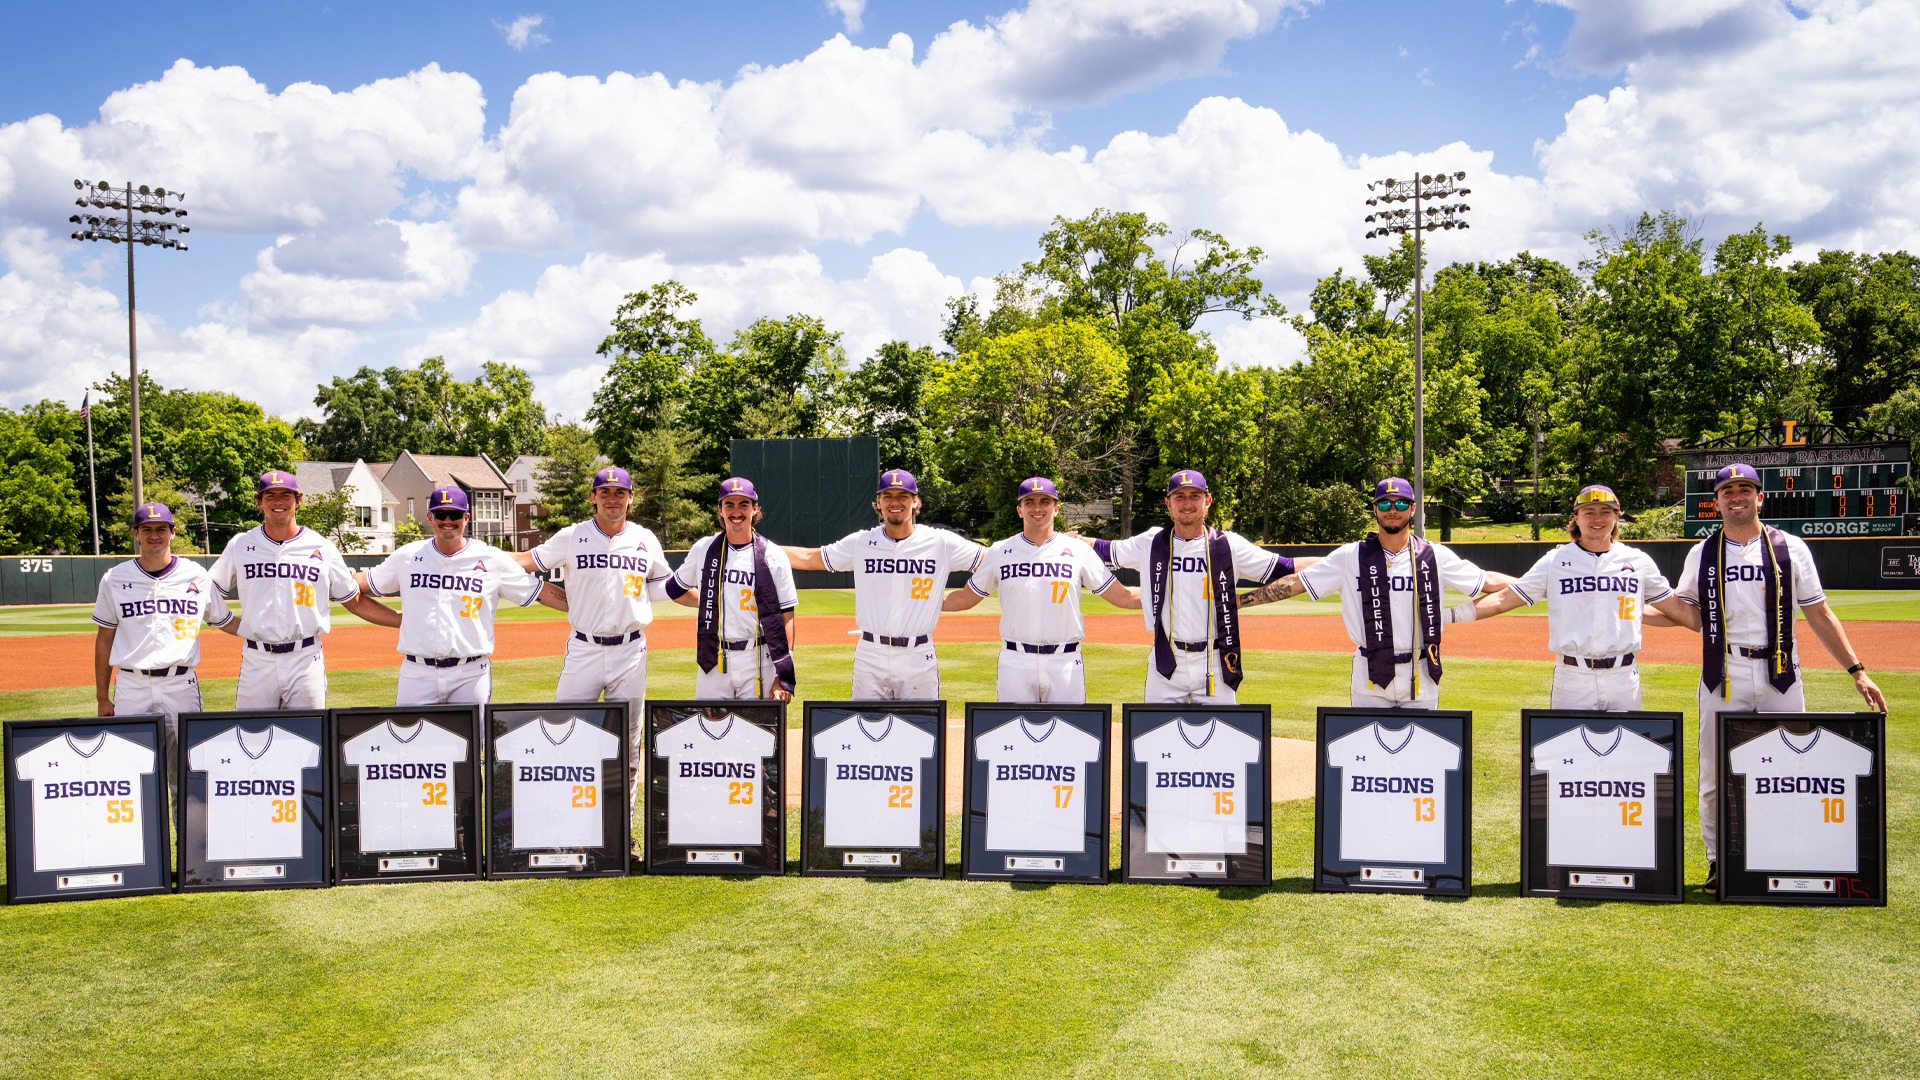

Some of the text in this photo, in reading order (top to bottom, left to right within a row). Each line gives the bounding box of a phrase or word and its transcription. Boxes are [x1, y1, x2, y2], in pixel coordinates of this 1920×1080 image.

[1782, 419, 1807, 447] L
[1706, 448, 1884, 467] LIPSCOMB BASEBALL
[271, 473, 284, 485] L
[607, 470, 618, 482] L
[1180, 473, 1192, 485] L
[1698, 472, 1704, 480] AT
[1729, 466, 1744, 479] L
[1780, 466, 1801, 476] STRIKE
[1832, 466, 1844, 475] OUT
[731, 480, 743, 492] L
[891, 473, 902, 486] L
[1032, 480, 1044, 491] L
[1386, 480, 1399, 493] L
[1786, 477, 1794, 490] 0
[1834, 475, 1842, 489] 0
[441, 491, 453, 503] L
[1840, 496, 1846, 506] 0
[1867, 495, 1874, 506] 0
[1890, 494, 1896, 505] 0
[147, 505, 161, 518] L
[1840, 506, 1846, 517] 0
[1866, 506, 1873, 516] 0
[1890, 506, 1896, 516] 0
[1801, 522, 1869, 534] GEORGE
[20, 559, 52, 573] 375
[244, 562, 320, 582] BISONS
[576, 554, 647, 573] BISONS
[865, 558, 936, 574] BISONS
[1000, 562, 1072, 580] BISONS
[411, 574, 482, 593] BISONS
[624, 574, 644, 597] 29
[911, 577, 933, 600] 22
[1154, 562, 1162, 614] STUDE
[1559, 576, 1639, 595] BISONS
[294, 582, 314, 608] 38
[705, 558, 718, 630] STUDENT
[1051, 581, 1070, 604] 17
[1421, 560, 1434, 636] ATHLETE
[120, 598, 198, 618] BISONS
[460, 595, 483, 620] 32
[1219, 570, 1232, 646] ATHLETE
[1370, 566, 1384, 642] STUDENT
[1617, 596, 1636, 621] 12
[1708, 566, 1717, 644] STUDENT
[174, 618, 199, 640] 55
[366, 764, 446, 780] BISONS
[519, 766, 594, 782] BISONS
[679, 762, 755, 778] BISONS
[837, 765, 912, 781] BISONS
[996, 765, 1075, 782] BISONS
[215, 780, 294, 796] BISONS
[1156, 772, 1234, 788] BISONS
[1351, 776, 1433, 793] BISONS
[1756, 777, 1844, 794] BISONS
[45, 781, 130, 799] BISONS
[422, 782, 448, 805] 32
[572, 785, 596, 808] 29
[729, 782, 754, 805] 23
[888, 785, 913, 808] 22
[1053, 785, 1073, 808] 17
[1559, 781, 1645, 798] BISONS
[107, 800, 134, 823] 55
[272, 800, 297, 823] 38
[1213, 792, 1234, 815] 15
[1413, 798, 1435, 822] 13
[1821, 798, 1844, 823] 10
[1619, 801, 1642, 826] 12
